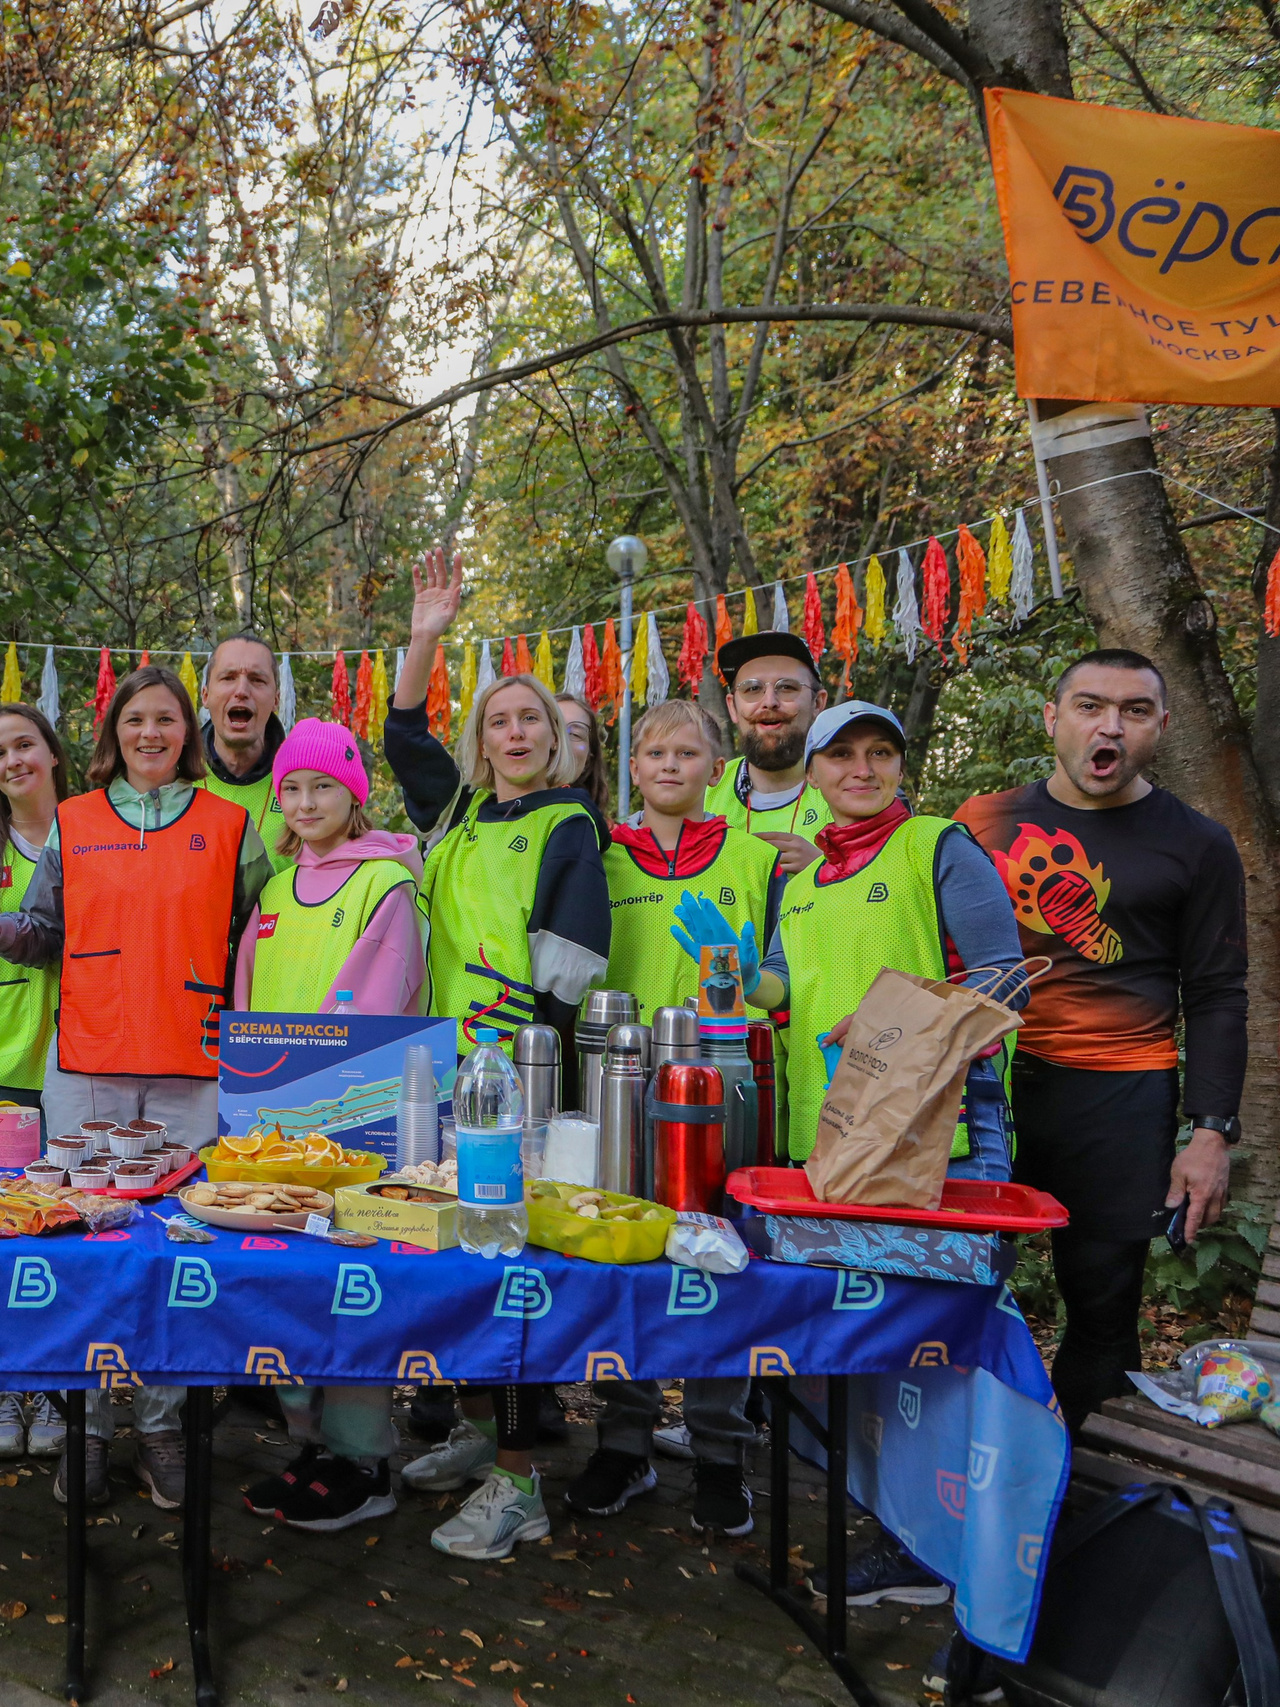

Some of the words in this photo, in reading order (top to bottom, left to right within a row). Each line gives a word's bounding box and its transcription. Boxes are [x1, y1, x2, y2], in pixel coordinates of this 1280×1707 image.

[1011, 280, 1200, 337] СЕВЕНОЕ
[1149, 335, 1266, 361] МОСКВА
[229, 1022, 283, 1035] СХЕМА
[285, 1024, 349, 1037] ТРАССЫ
[229, 1036, 235, 1044] 5
[235, 1034, 262, 1044] ВЁРСТ
[263, 1037, 308, 1046] СЕВЕРНОЕ
[306, 1038, 348, 1047] ТУШИНО
